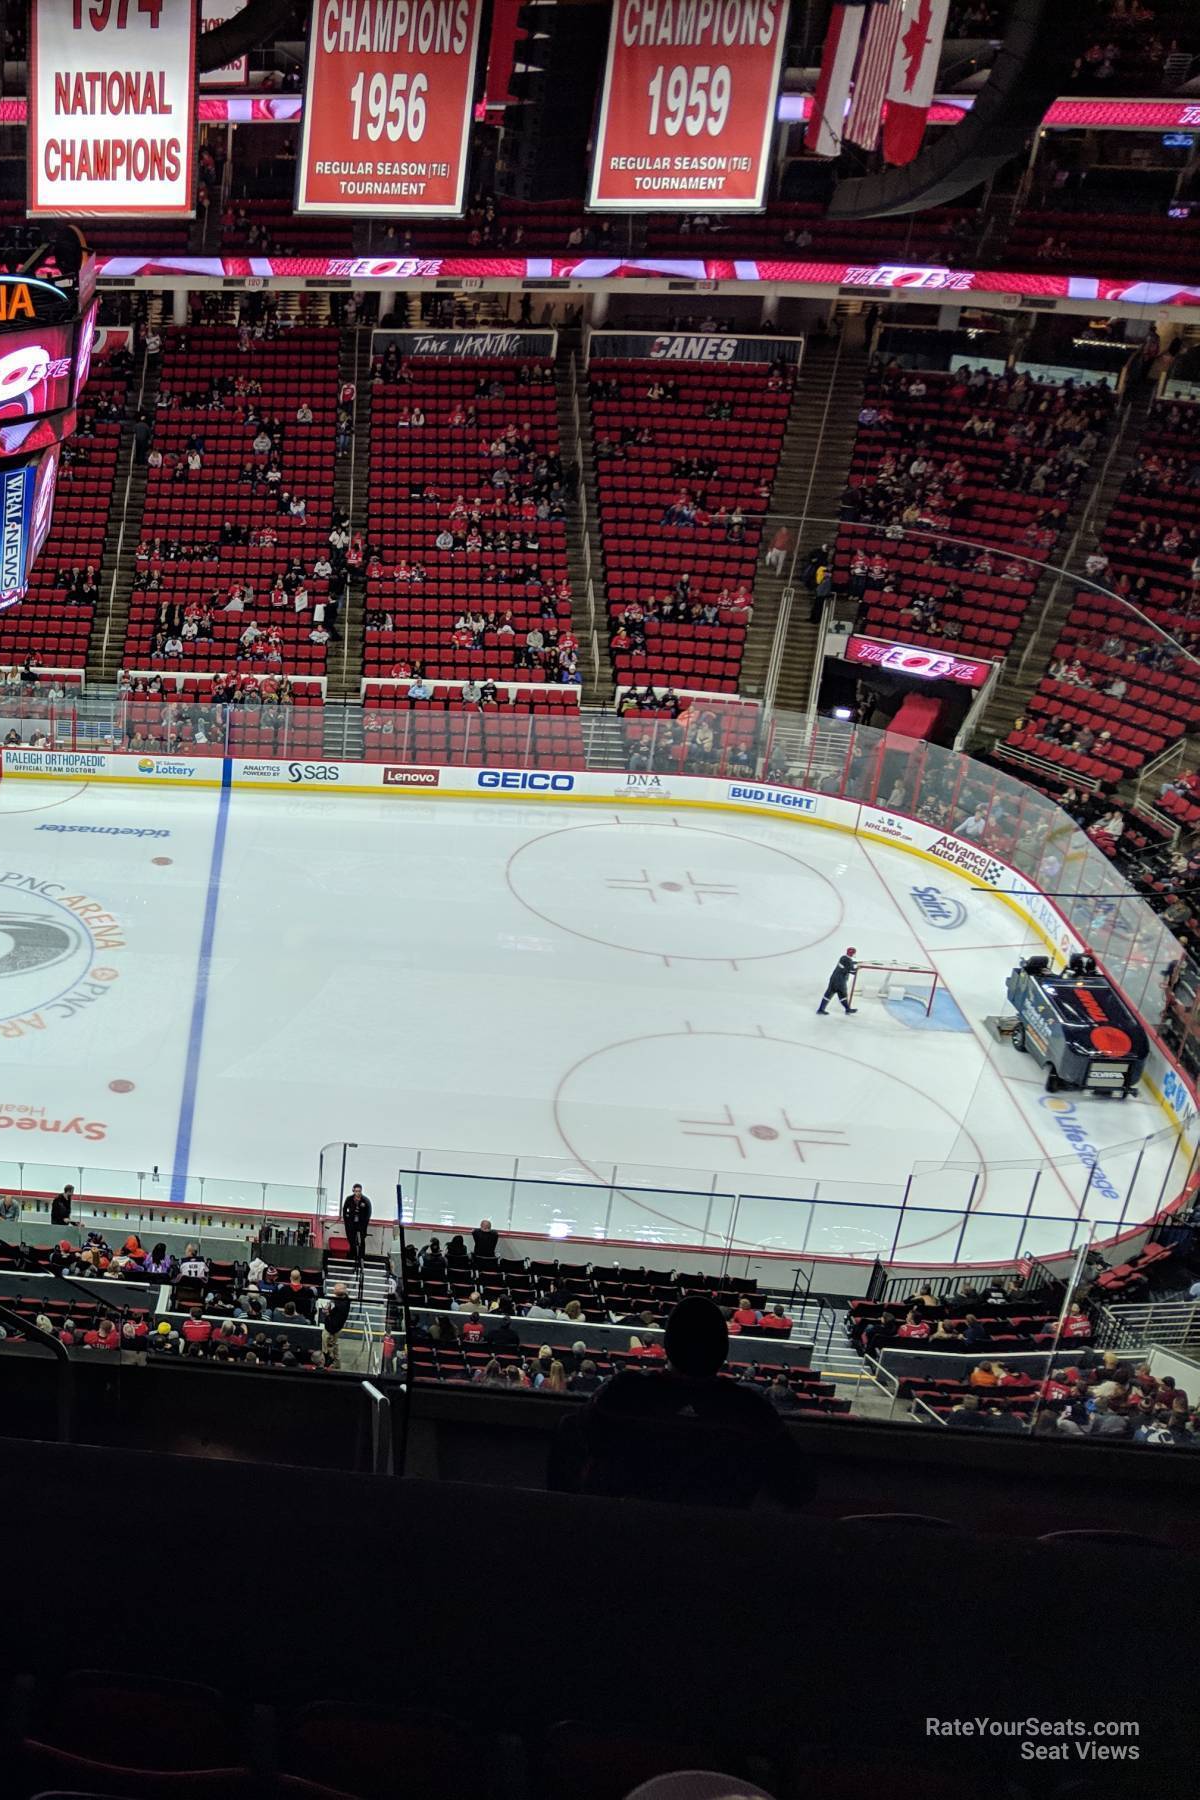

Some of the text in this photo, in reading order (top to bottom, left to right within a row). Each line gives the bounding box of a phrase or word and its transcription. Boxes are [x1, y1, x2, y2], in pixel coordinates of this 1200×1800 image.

[323, 0, 469, 54] CHAMPIONS
[623, 0, 776, 47] CHAMPIONS
[55, 71, 172, 115] NATIONAL
[648, 65, 731, 136] 1959
[351, 72, 428, 142] 1956
[44, 138, 181, 182] CHAMPIONS
[316, 162, 450, 178] REGULAR SEASON (TIE)
[610, 157, 752, 172] REGULAR SEASON (TIE)
[340, 181, 426, 195] TOURNAMENT
[634, 177, 726, 190] TOURNAMENT
[327, 259, 444, 276] THE EYE
[843, 267, 975, 290] THE EYE
[413, 333, 524, 357] TAKE WARNING
[651, 336, 737, 360] CANES
[27, 358, 72, 380] EYE
[6, 473, 24, 527] WRAL
[4, 529, 20, 588] NEWS
[858, 644, 977, 680] THE EYE
[5, 752, 105, 767] RALEIGH ORTHOPAEDIC
[156, 766, 195, 776] Lottery
[387, 771, 434, 783] Lenovo
[478, 771, 574, 791] GEICO
[627, 775, 661, 786] DNA
[732, 787, 813, 809] BUD LIGHT
[34, 824, 171, 838] ticketmaster
[926, 845, 982, 875] Auto Parts
[936, 836, 987, 867] Advance
[0, 871, 127, 950] PNC ARENA
[909, 886, 953, 920] Spirit
[45, 981, 111, 1018] PNC
